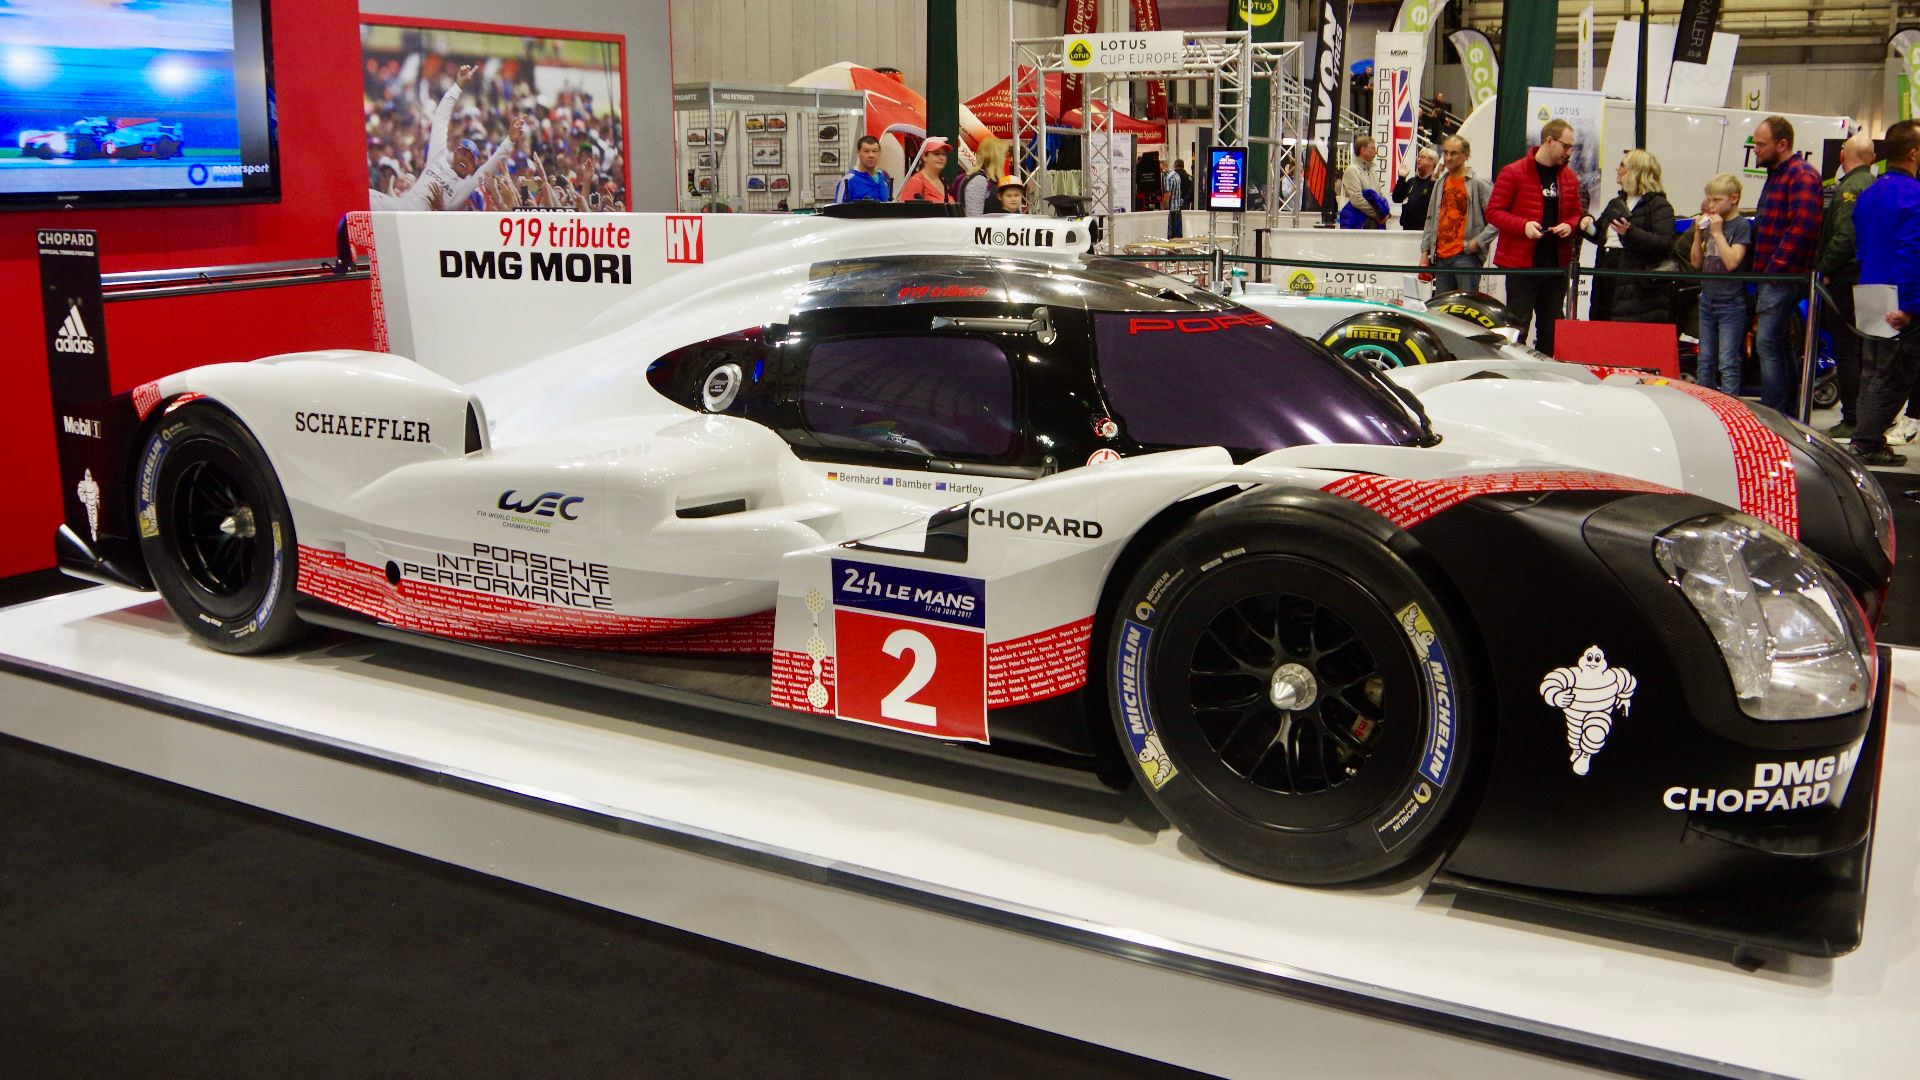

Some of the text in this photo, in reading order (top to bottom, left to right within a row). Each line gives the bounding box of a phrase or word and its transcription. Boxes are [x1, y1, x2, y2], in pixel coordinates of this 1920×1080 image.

[1101, 40, 1147, 50] LOTUS
[1101, 52, 1179, 65] CUP EUROPE
[1333, 24, 1343, 88] TYRES
[1315, 2, 1337, 163] AVON
[1378, 68, 1390, 116] ELISE
[1555, 107, 1579, 116] LOTUS
[212, 164, 269, 175] motorsport
[38, 232, 94, 246] CHOPARD
[500, 217, 630, 248] 919 tribute
[666, 218, 702, 261] HY
[975, 227, 1054, 246] Mobil 1
[440, 250, 632, 284] DMG MORI
[1325, 273, 1377, 284] LOTUS
[898, 284, 989, 301] 919 tribute
[55, 336, 95, 354] adidas
[1346, 325, 1401, 342] PIRELLI
[64, 415, 91, 438] Mobil
[295, 411, 431, 443] SCHAEFFLER
[141, 440, 164, 501] MICHELIN
[839, 473, 984, 495] Bernhard Bamber Hartley
[488, 512, 511, 521] WORLD
[511, 516, 552, 527] ENDURANCE
[497, 490, 584, 521] WEC
[502, 521, 550, 534] CHAMPIONSHIP
[970, 507, 1103, 539] CHOPARD
[436, 553, 610, 595] INTELLIGENT
[473, 543, 609, 580] PORSCHE
[403, 563, 615, 611] PERFORMANCE
[842, 568, 975, 611] 24h LE MANS
[1146, 571, 1170, 602] MICHELIN
[942, 607, 956, 616] JUIN
[957, 609, 972, 618] 2017
[881, 628, 937, 727] 2
[1121, 626, 1141, 735] MICHELIN
[1429, 661, 1450, 780] MICHELIN
[1754, 755, 1836, 787] DMG
[1663, 781, 1831, 812] CHOPARD
